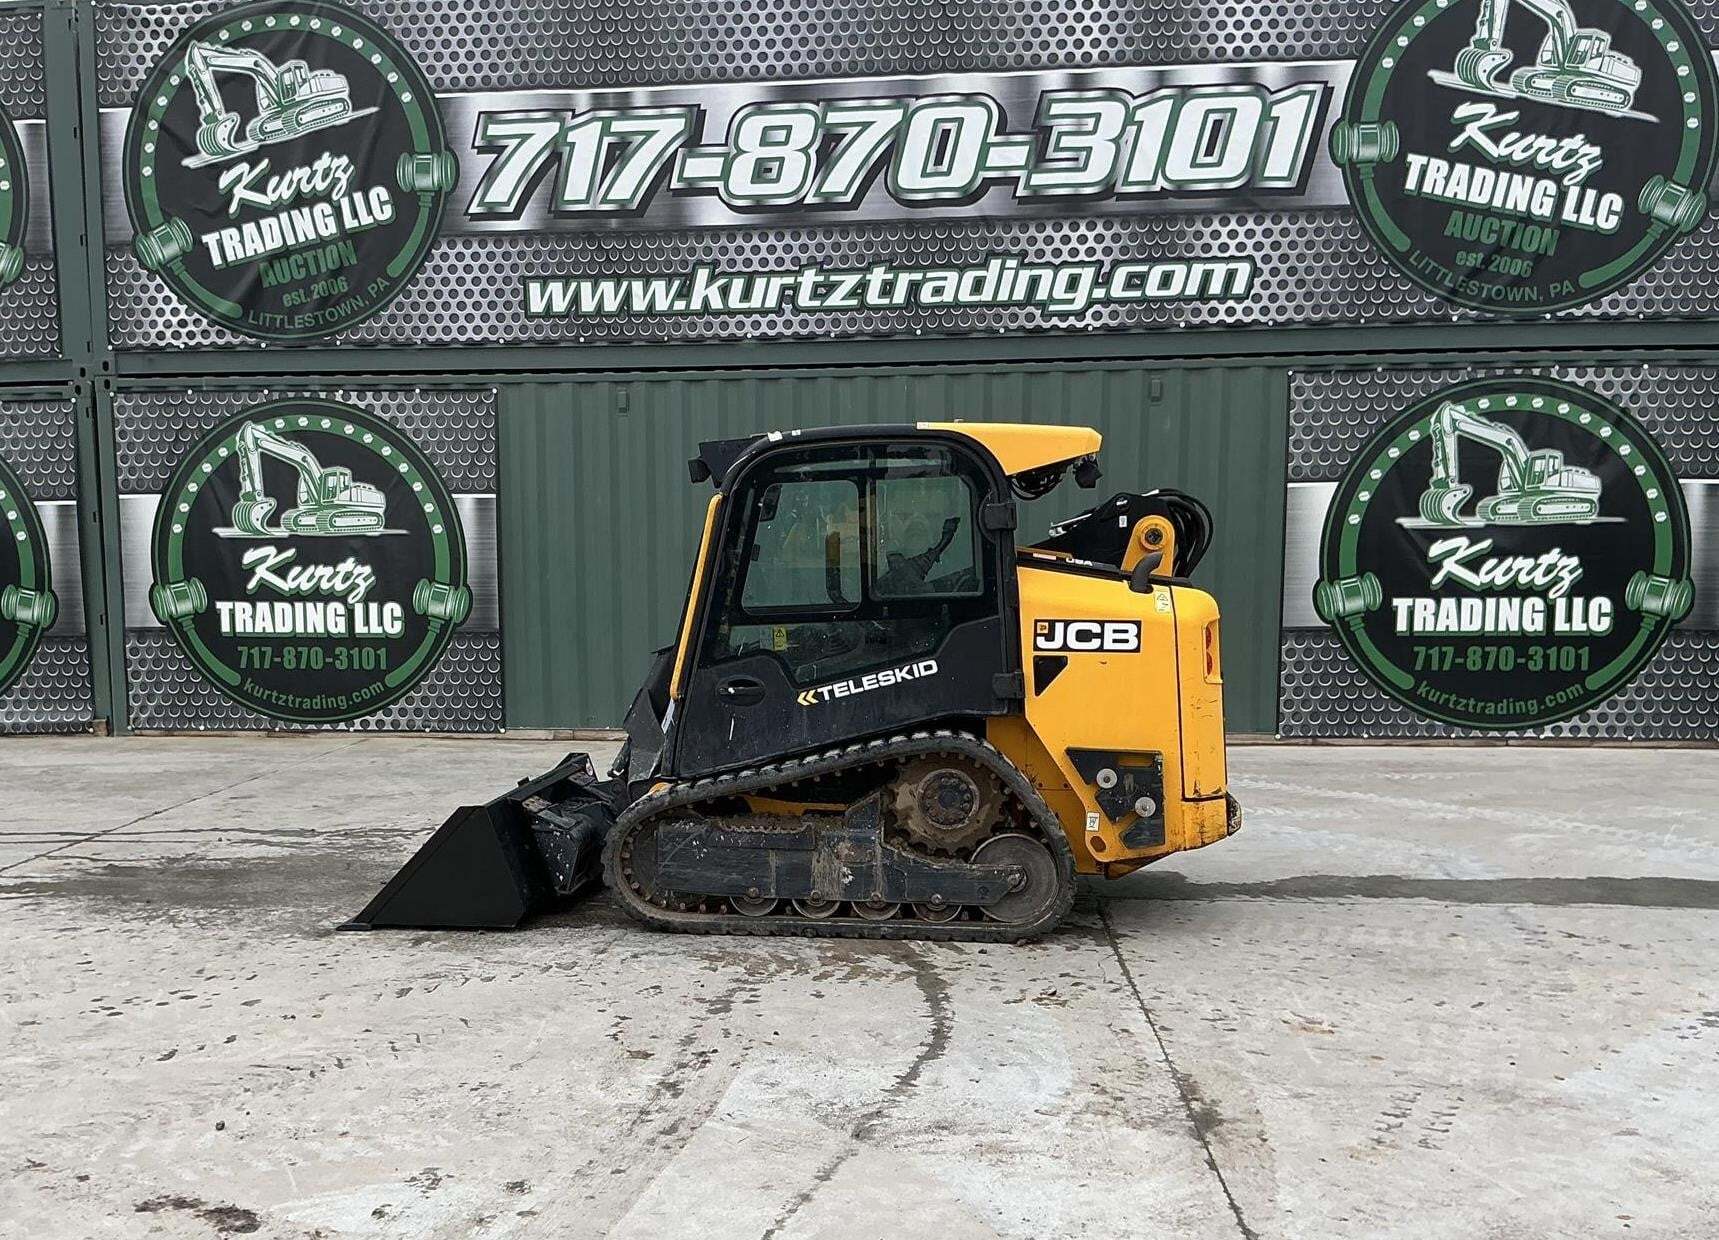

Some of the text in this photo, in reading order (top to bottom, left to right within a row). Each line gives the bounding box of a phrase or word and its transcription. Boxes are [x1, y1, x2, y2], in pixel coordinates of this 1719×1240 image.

[470, 87, 1322, 216] 717-870-3101
[1449, 101, 1602, 186] Kurtz
[219, 152, 353, 214] Kurtz
[1404, 153, 1624, 232] TRADING LLC
[202, 186, 393, 269] TRADING LLC
[1444, 211, 1559, 257] AUCTION
[259, 241, 358, 289] AUCTION
[525, 256, 1255, 316] www.kurtztrading.com
[1409, 250, 1575, 302] LITTLESTOWN, PA
[1455, 250, 1532, 279] est. 2006
[247, 276, 390, 330] LITTLESTOWN, PA
[282, 277, 348, 308] est. 2006
[242, 546, 376, 604] Kurtz
[1429, 536, 1583, 597] Kurtz
[216, 602, 404, 637] TRADING LLC
[1036, 622, 1139, 650] JCB
[1392, 597, 1614, 636] TRADING LLC
[237, 646, 388, 671] 717-870-3101
[816, 659, 938, 701] TELESKID
[1413, 646, 1590, 672] 717-870-3101
[244, 678, 385, 710] kurtztrading.com
[1416, 681, 1584, 715] kurtztrading.com
